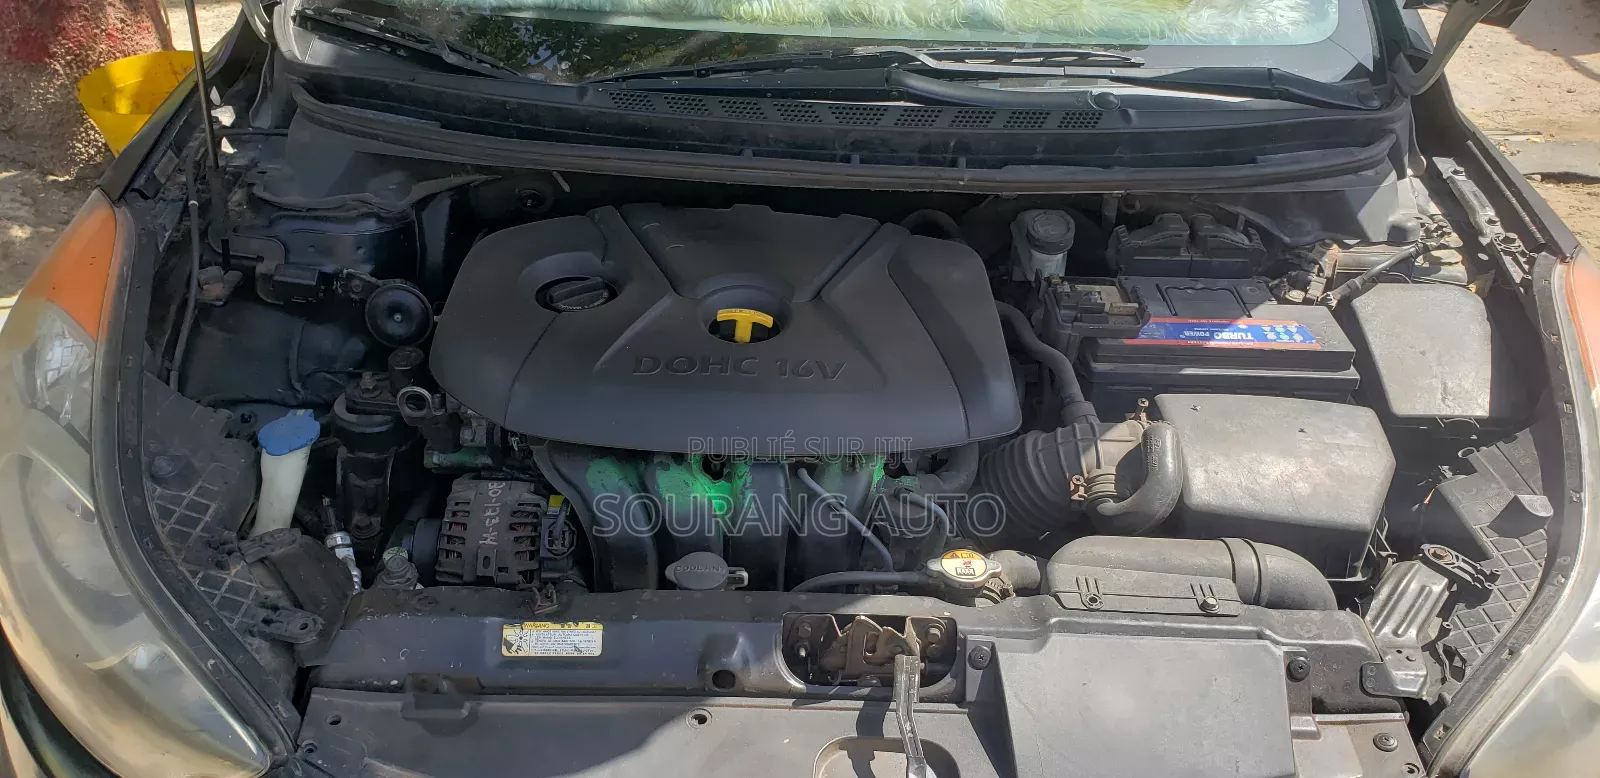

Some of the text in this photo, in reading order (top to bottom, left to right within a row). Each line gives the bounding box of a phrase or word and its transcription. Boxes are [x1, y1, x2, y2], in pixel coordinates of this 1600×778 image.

[1213, 331, 1255, 340] TURBO
[632, 355, 848, 381] DOHC 16V
[675, 564, 726, 574] COOLANT
